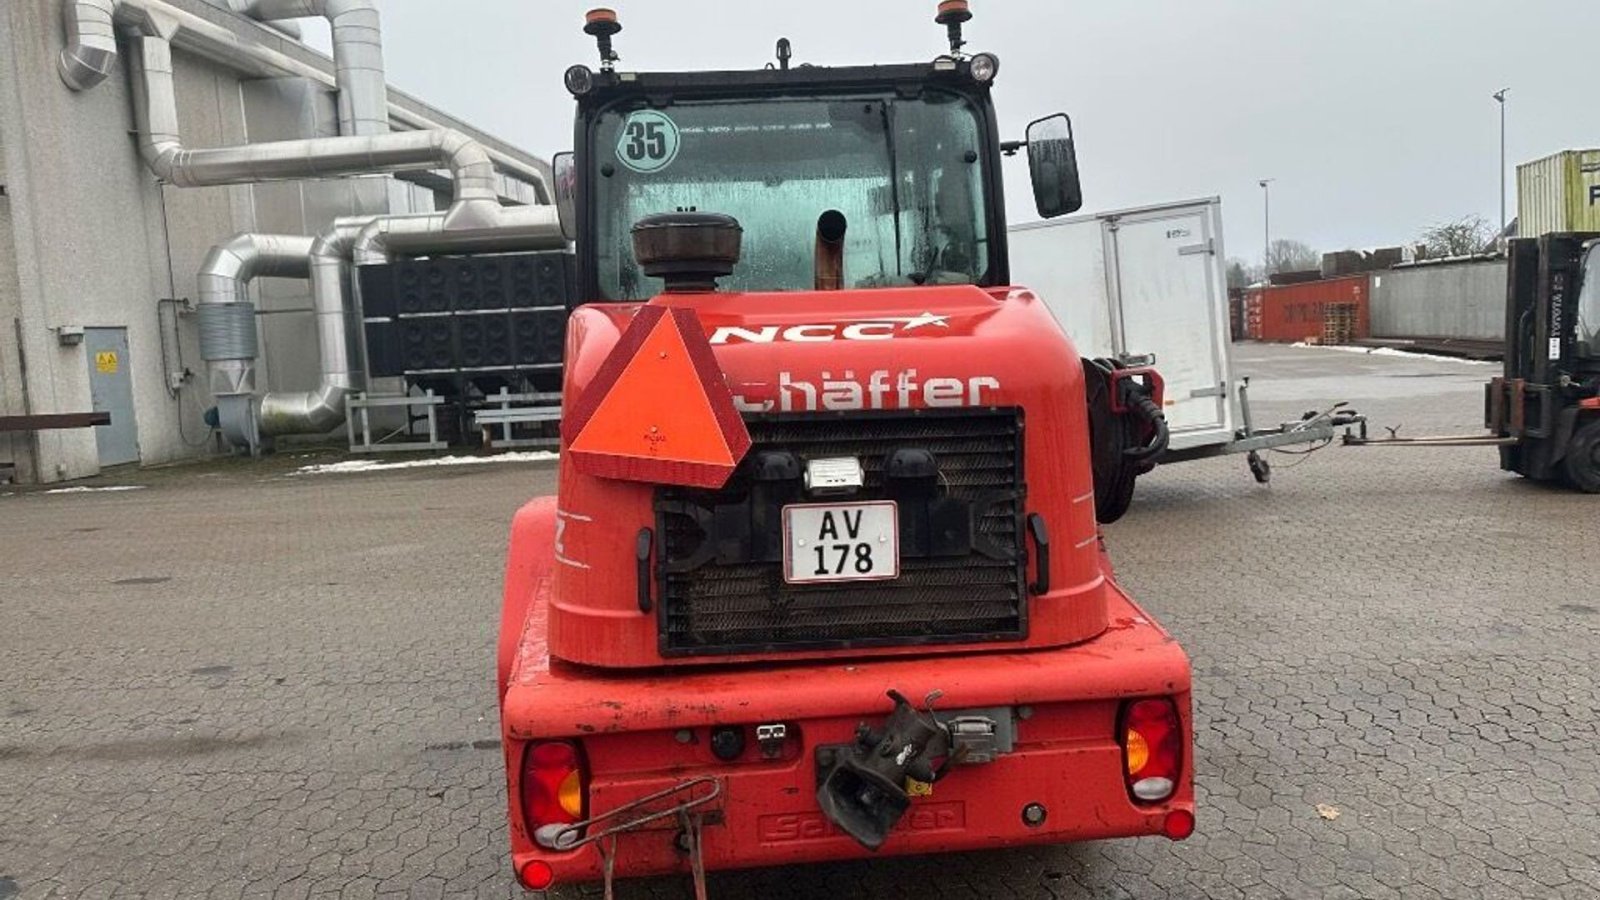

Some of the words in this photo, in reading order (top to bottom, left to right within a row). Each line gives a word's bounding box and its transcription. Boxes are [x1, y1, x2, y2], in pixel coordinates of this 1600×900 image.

[626, 121, 666, 161] 35
[709, 322, 896, 344] NCC
[818, 509, 863, 541] AV
[814, 542, 874, 576] 178
